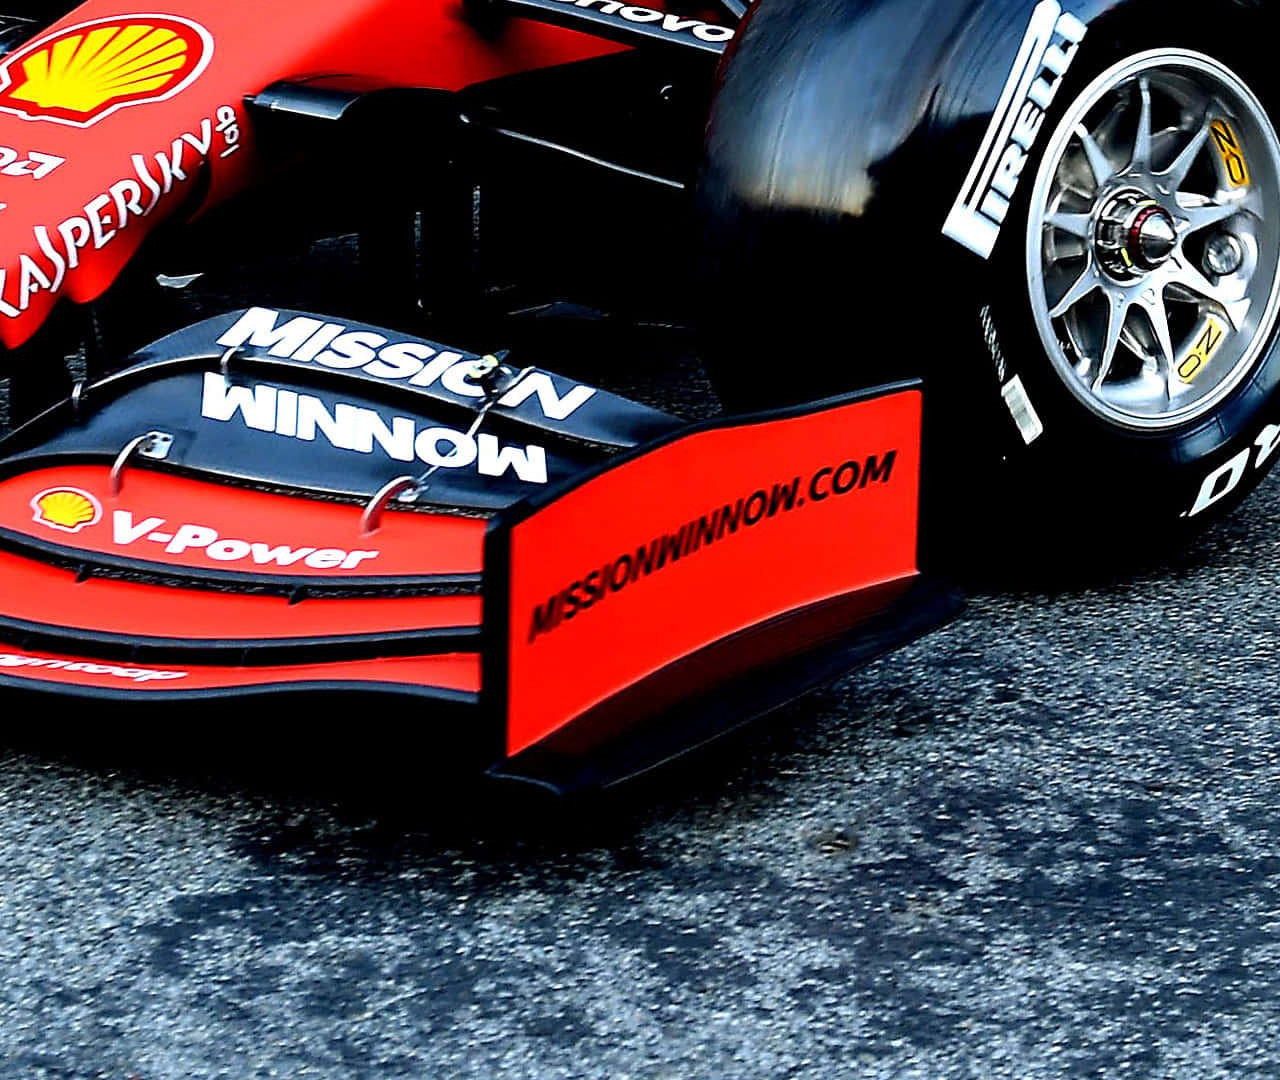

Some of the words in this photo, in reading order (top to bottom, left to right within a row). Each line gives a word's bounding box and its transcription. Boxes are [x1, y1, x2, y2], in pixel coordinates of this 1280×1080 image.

[217, 306, 596, 421] MISSION
[202, 373, 549, 485] WINNOW
[110, 510, 379, 570] V-Power
[528, 450, 897, 644] MISSIONWINNOW.COM
